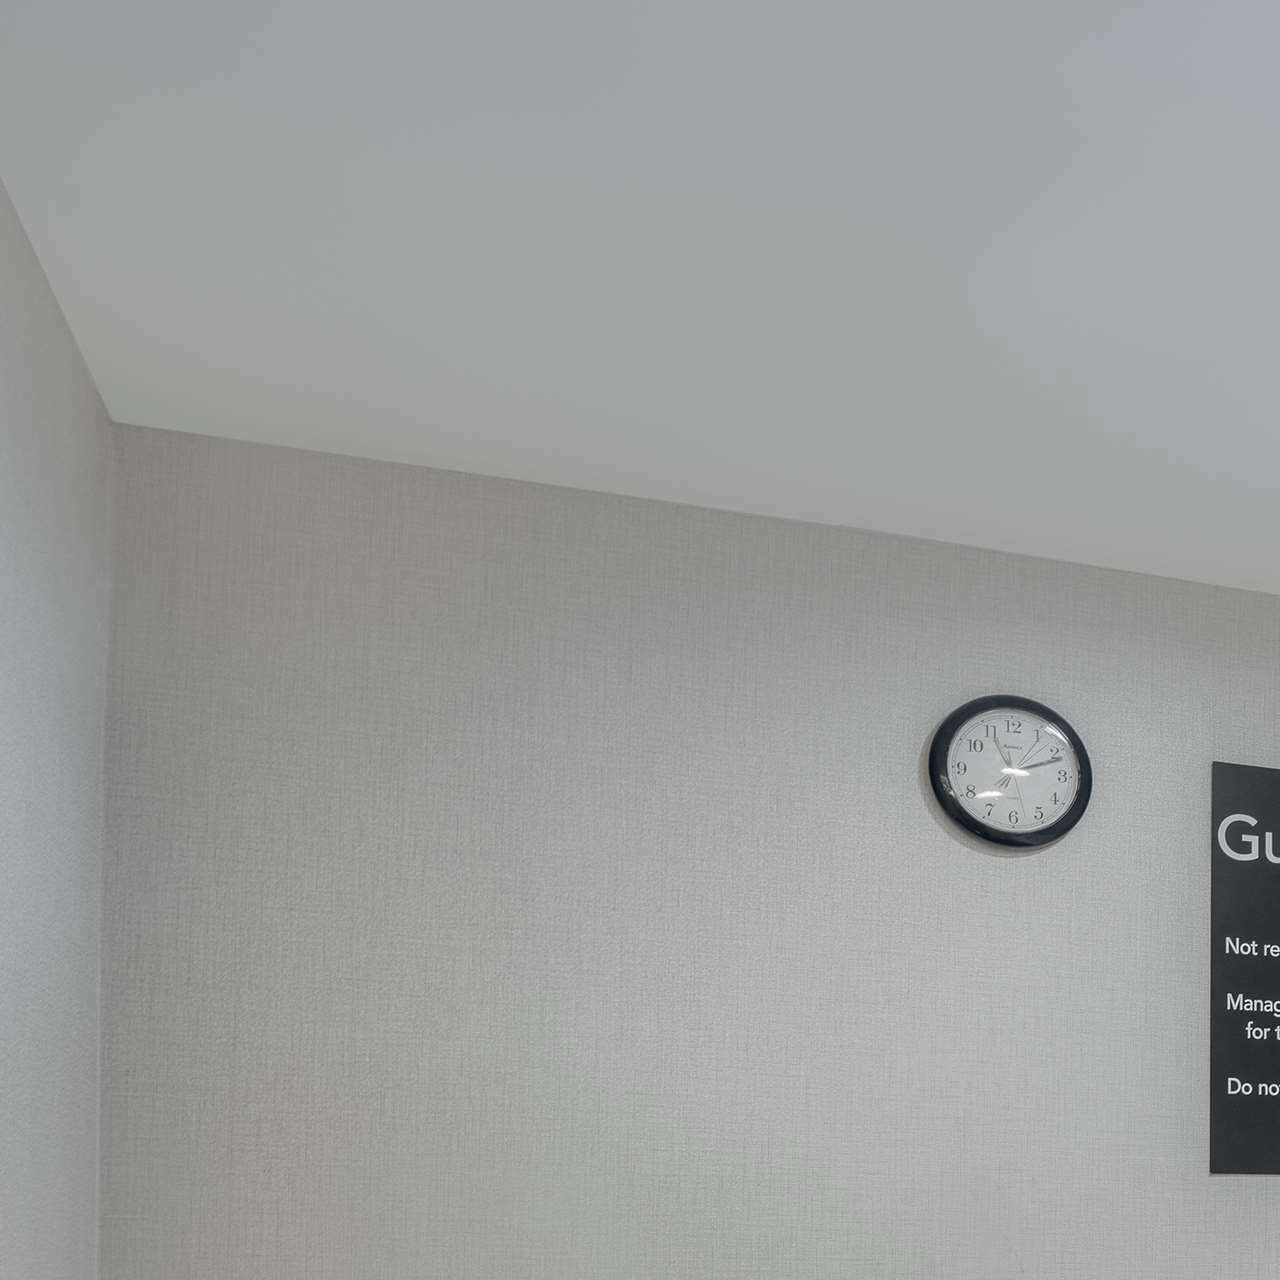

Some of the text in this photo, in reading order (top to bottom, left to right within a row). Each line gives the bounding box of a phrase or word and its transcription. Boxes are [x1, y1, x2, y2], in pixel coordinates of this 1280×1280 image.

[985, 725, 997, 740] 11
[1005, 719, 1022, 734] 12
[968, 739, 984, 752] 10
[1050, 746, 1061, 760] 2
[957, 761, 967, 775] 9
[1058, 770, 1067, 783] 3
[966, 785, 976, 798] 8
[1050, 792, 1059, 804] 4
[985, 803, 995, 817] 7
[1008, 810, 1018, 824] 6
[1034, 806, 1043, 820] 5
[1225, 937, 1258, 956] Not
[1245, 1021, 1271, 1040] for
[1227, 1077, 1253, 1095] Do
